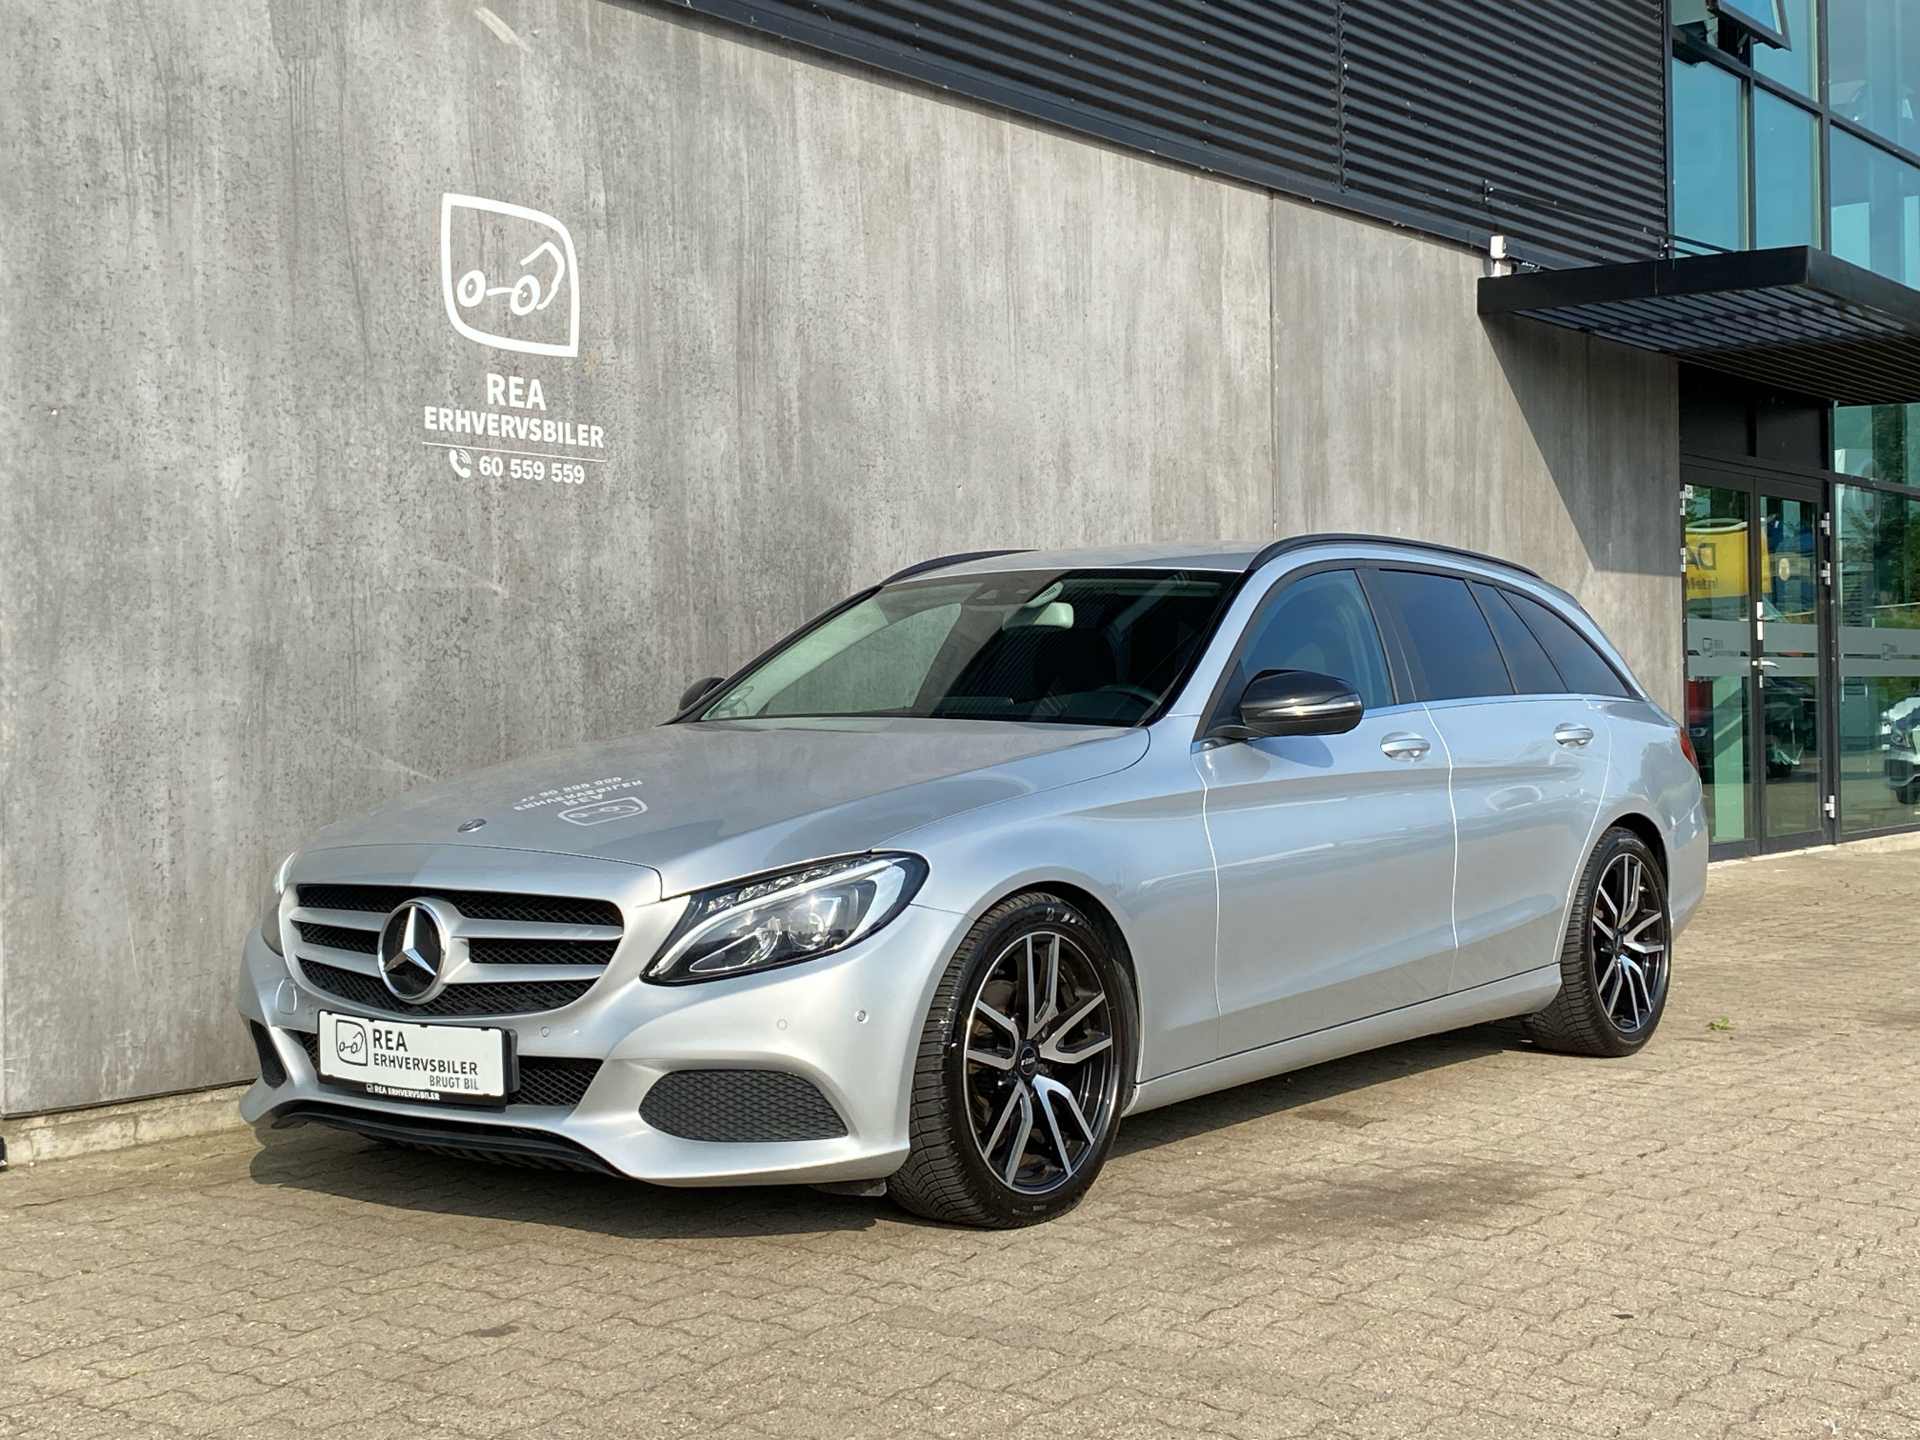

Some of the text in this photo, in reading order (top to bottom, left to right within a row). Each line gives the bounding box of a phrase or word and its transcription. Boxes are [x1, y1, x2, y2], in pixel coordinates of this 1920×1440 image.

[487, 373, 546, 410] REA
[424, 406, 604, 448] ERHVERVSBILER
[479, 456, 586, 484] 60 559 559
[372, 1028, 408, 1051] REA
[373, 1053, 478, 1075] ERHVERVSBILER
[374, 1085, 440, 1100] REA ERHVERVSBILER
[429, 1075, 479, 1091] BRUGT BIL
